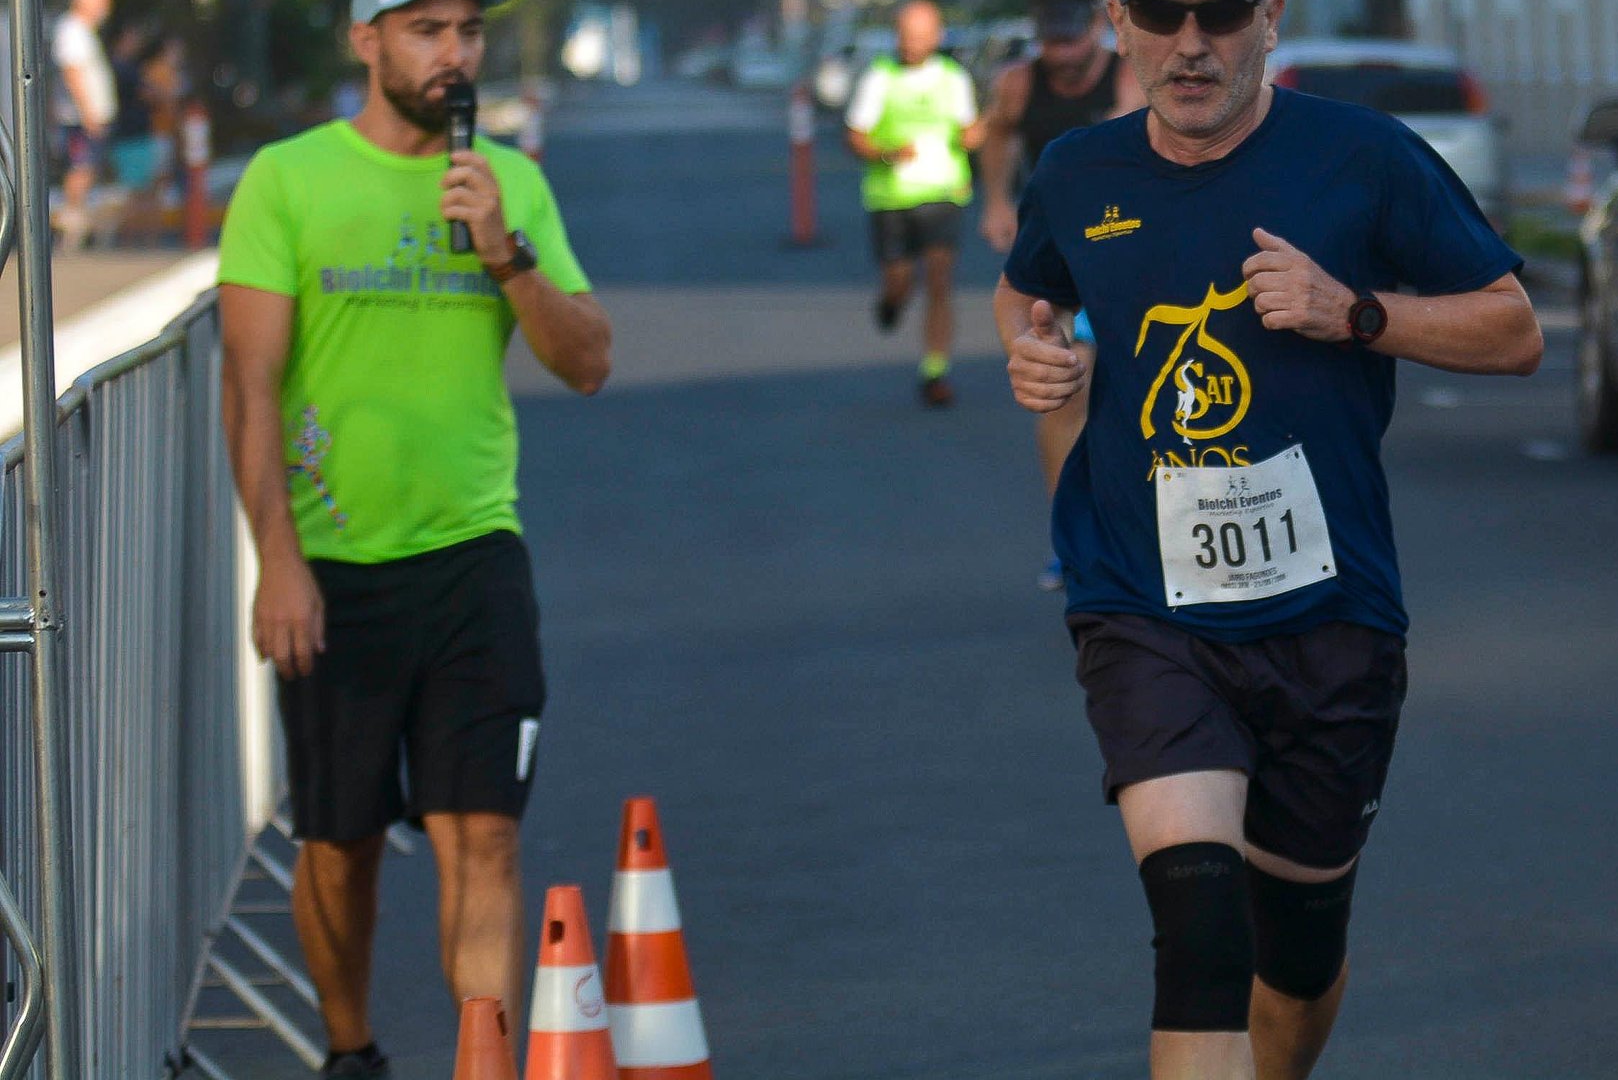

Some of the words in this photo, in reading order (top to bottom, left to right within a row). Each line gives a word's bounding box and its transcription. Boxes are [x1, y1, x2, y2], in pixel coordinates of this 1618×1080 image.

[1198, 496, 1237, 511] Biolchi
[1240, 488, 1283, 508] Eventos
[1191, 508, 1298, 570] 3011
